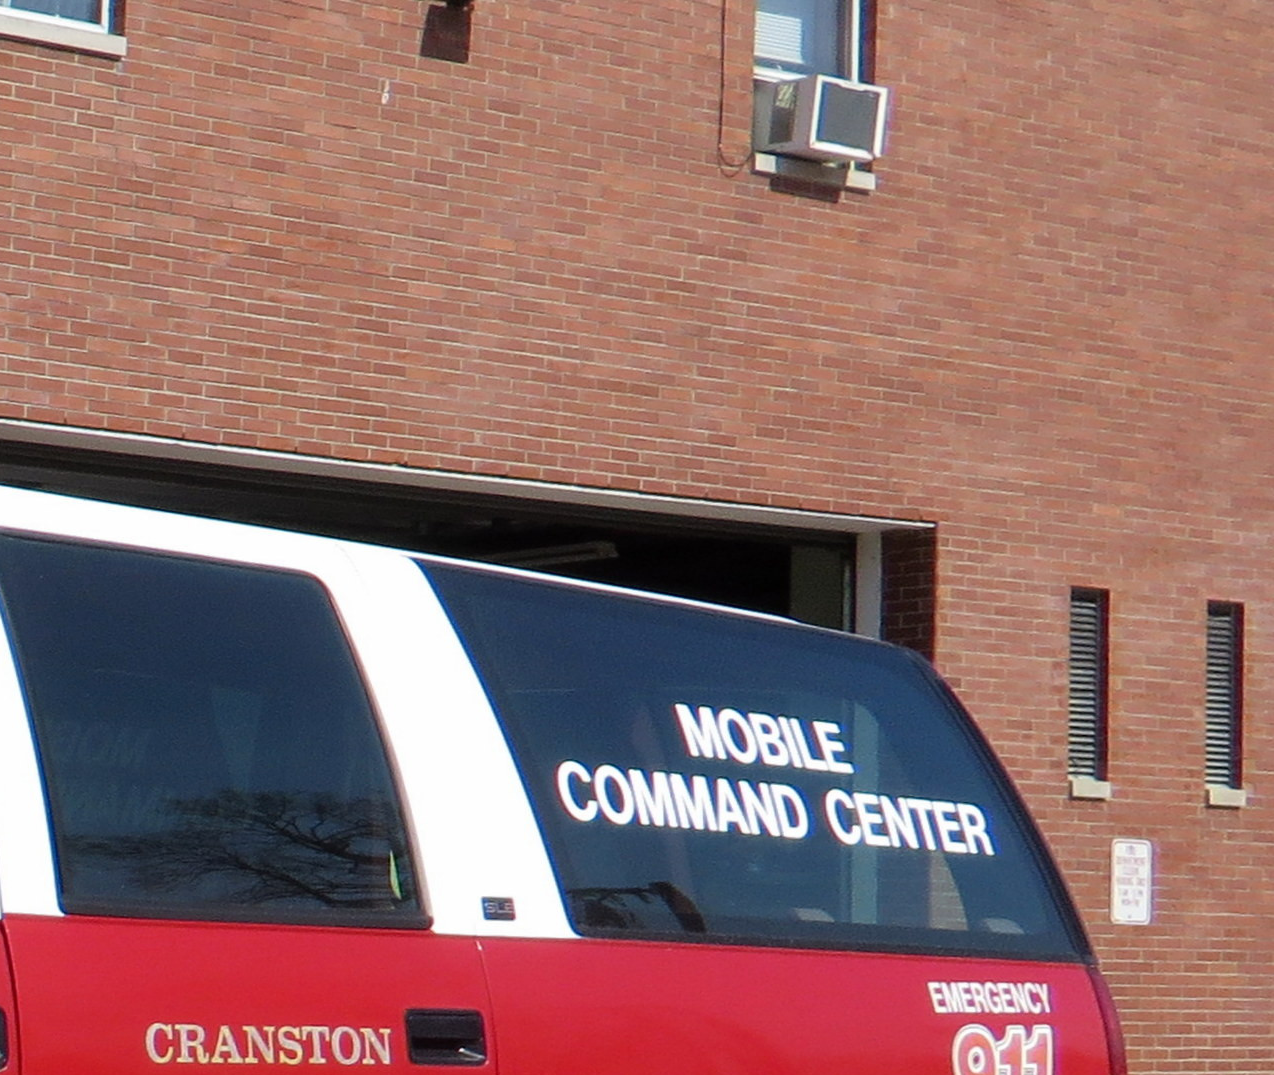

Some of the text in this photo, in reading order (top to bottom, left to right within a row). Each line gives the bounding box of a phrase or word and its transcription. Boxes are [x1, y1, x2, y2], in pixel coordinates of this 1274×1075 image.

[673, 702, 855, 775] MOBILE
[556, 759, 996, 856] COMMAND CENTER
[485, 902, 514, 914] SLE
[927, 981, 1051, 1014] EMERGENCY
[145, 1022, 392, 1065] CRANSTON
